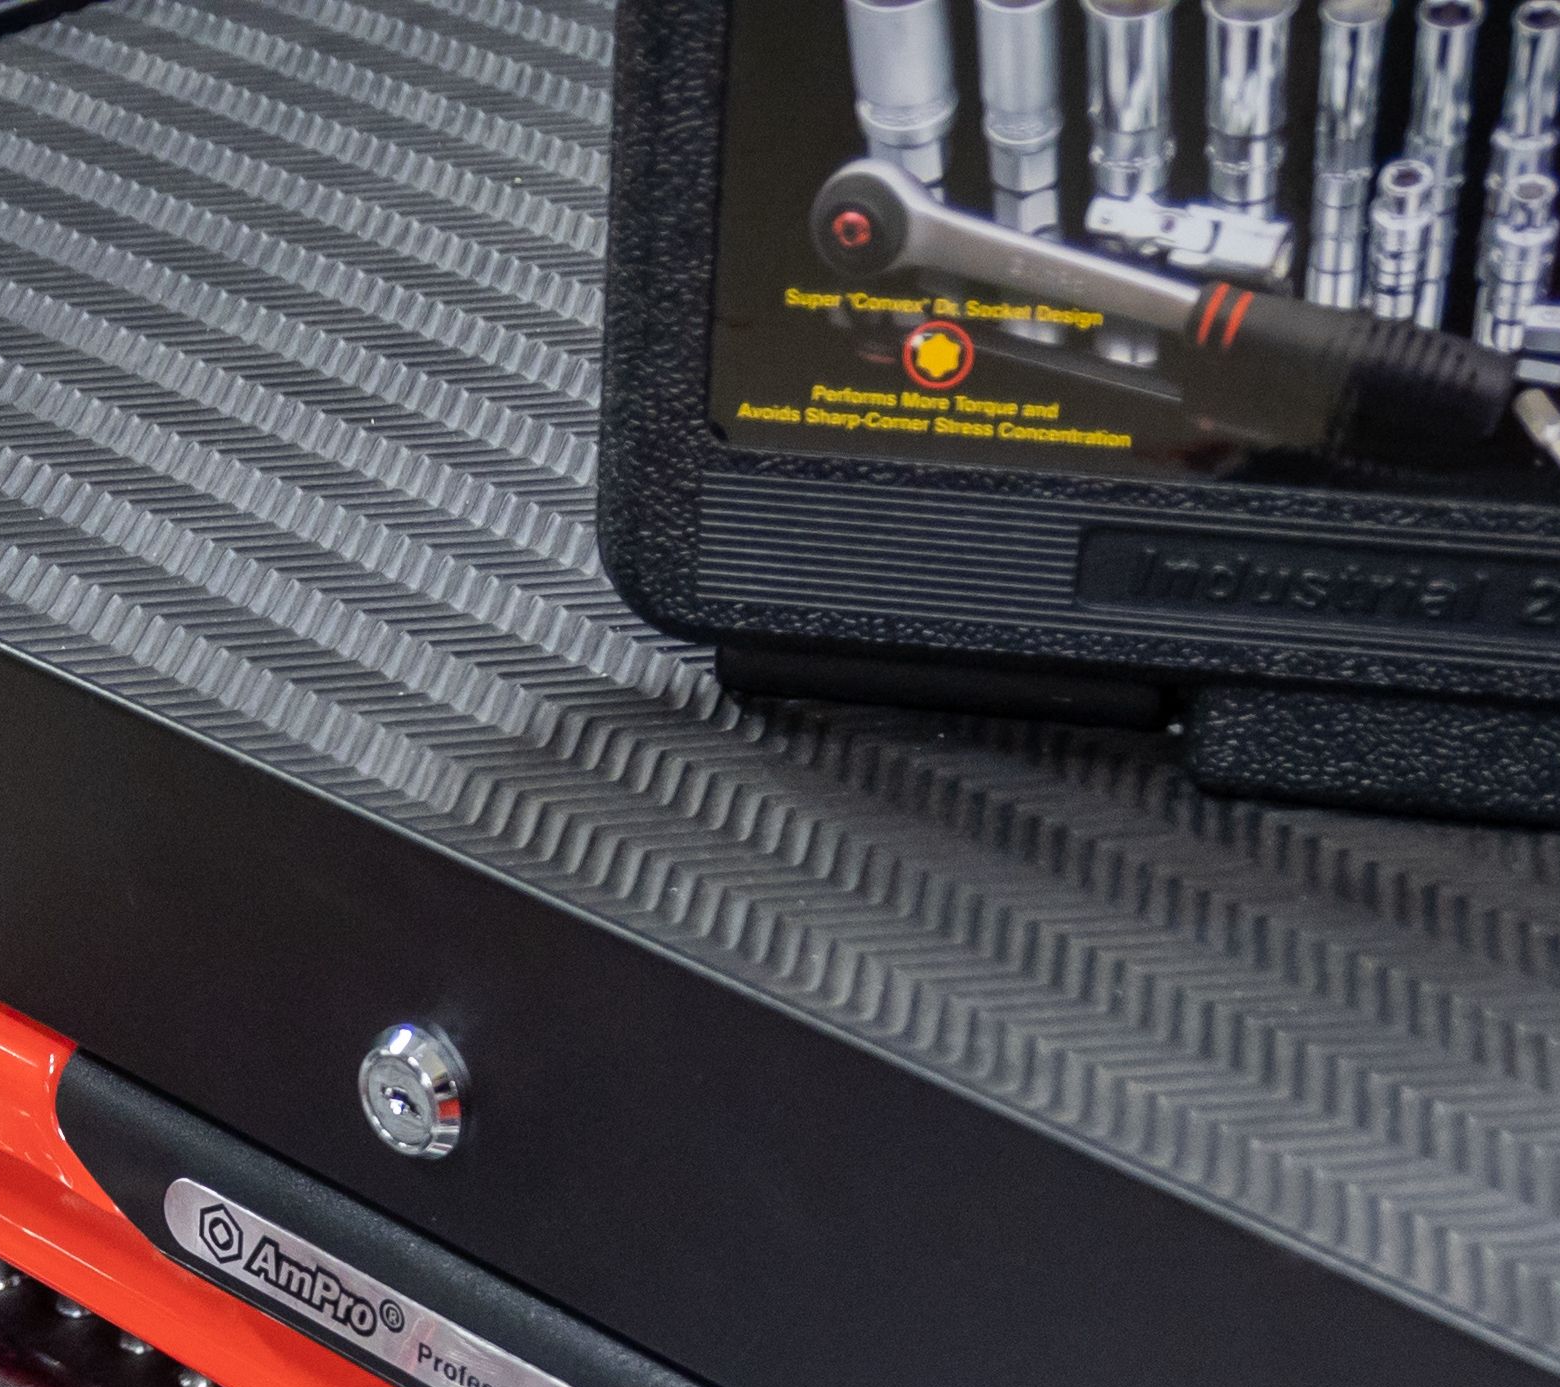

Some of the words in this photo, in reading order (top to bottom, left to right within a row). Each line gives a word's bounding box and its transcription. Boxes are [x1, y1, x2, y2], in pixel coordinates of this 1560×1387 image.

[784, 287, 842, 310] Super
[965, 299, 1031, 320] Socket
[1036, 304, 1104, 330] Design
[811, 384, 898, 407] Performs
[900, 391, 949, 409] More
[955, 395, 1018, 417] Torque
[1022, 402, 1059, 420] and
[737, 402, 801, 423] Avoids
[804, 406, 929, 430] Sharp-Corner
[934, 416, 994, 437] Stress
[997, 421, 1132, 447] Concentration
[1128, 546, 1488, 620] Industrial
